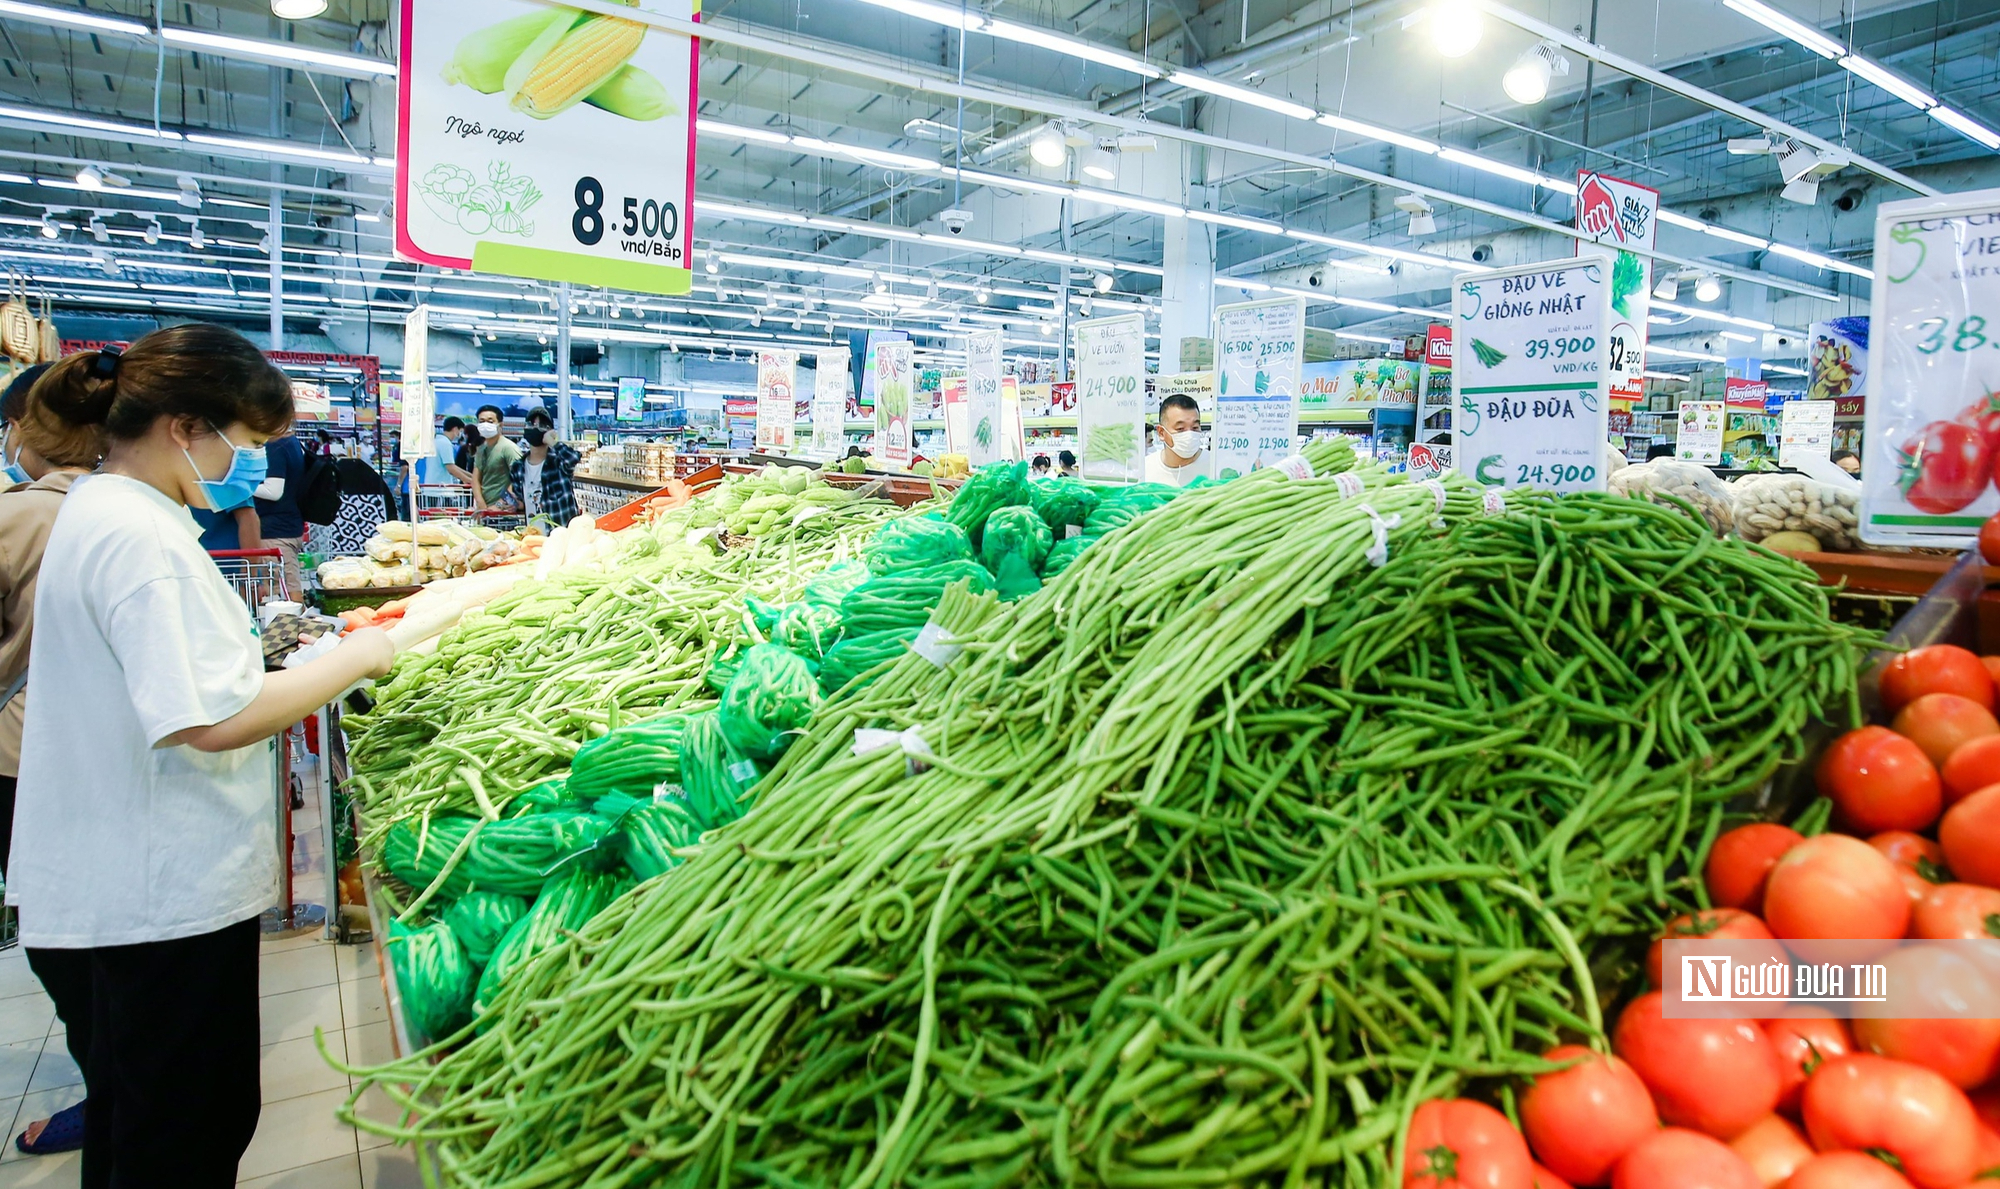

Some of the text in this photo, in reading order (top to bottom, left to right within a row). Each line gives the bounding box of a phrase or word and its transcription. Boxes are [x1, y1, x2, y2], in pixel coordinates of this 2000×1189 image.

[445, 116, 525, 145] Ngô ngọt
[572, 176, 678, 246] 8.500
[1624, 195, 1641, 213] GIÁ
[621, 240, 682, 260] vnd/Bắp
[1502, 271, 1567, 296] ĐẬU VE
[1484, 292, 1586, 320] GIỐNG NHẬT
[1101, 325, 1117, 341] ĐẬU
[1091, 344, 1102, 355] VE
[1223, 340, 1253, 355] 16.500
[1260, 340, 1296, 357] 25.500
[1525, 336, 1596, 360] 39.900
[1553, 361, 1598, 373] VND/KG
[1086, 375, 1137, 398] 24.900
[1313, 375, 1340, 394] Mai
[1382, 388, 1401, 403] Pho
[1487, 396, 1575, 423] ĐẬU ĐŨA
[1218, 437, 1289, 451] 22.900 22.900
[1516, 463, 1596, 486] 24.900
